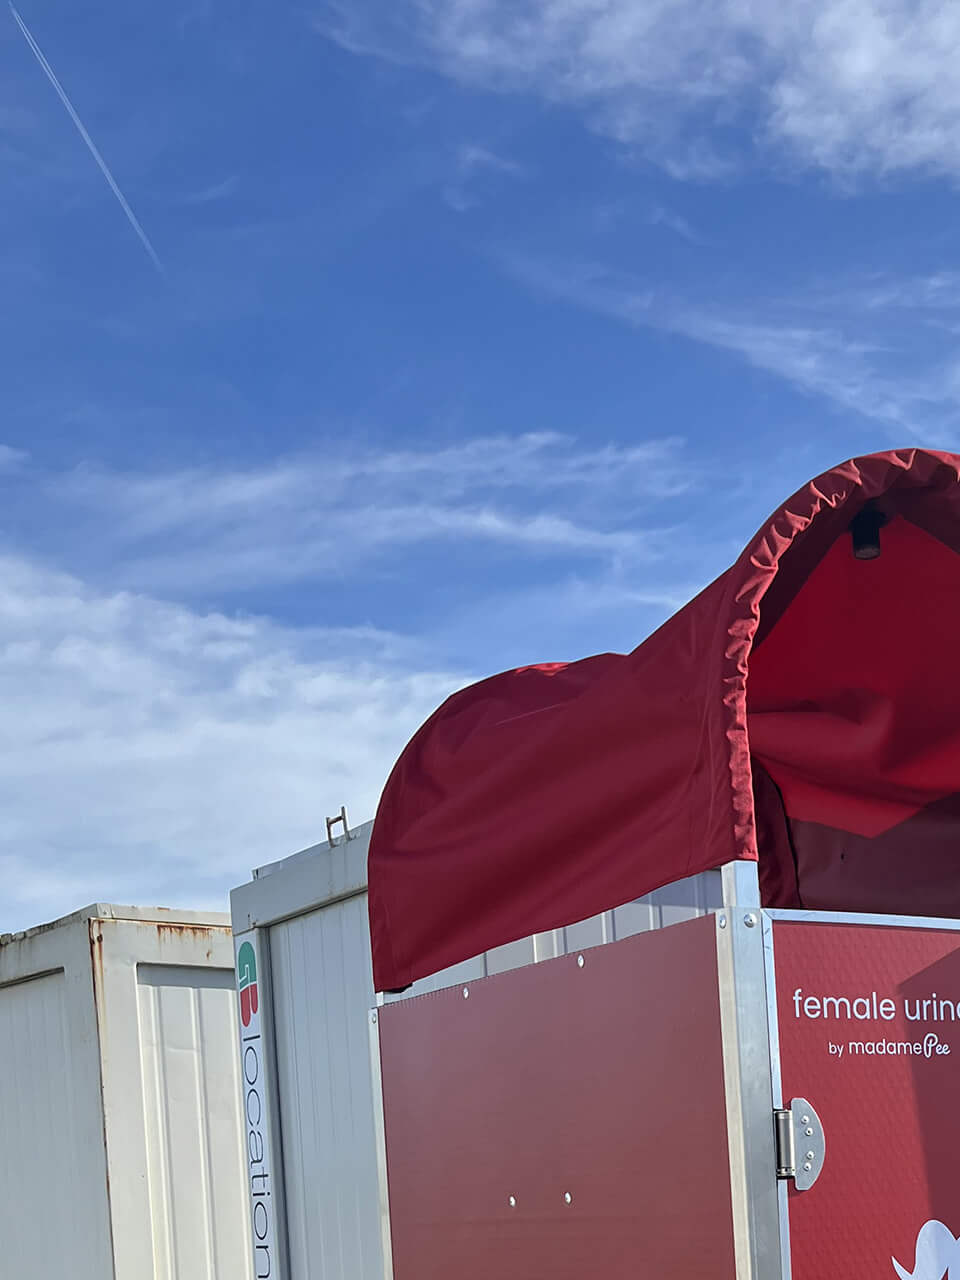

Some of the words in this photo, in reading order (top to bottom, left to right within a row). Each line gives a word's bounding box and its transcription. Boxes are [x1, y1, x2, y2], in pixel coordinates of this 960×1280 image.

[792, 988, 896, 1020] female
[828, 1041, 844, 1058] by
[243, 1034, 271, 1280] location
